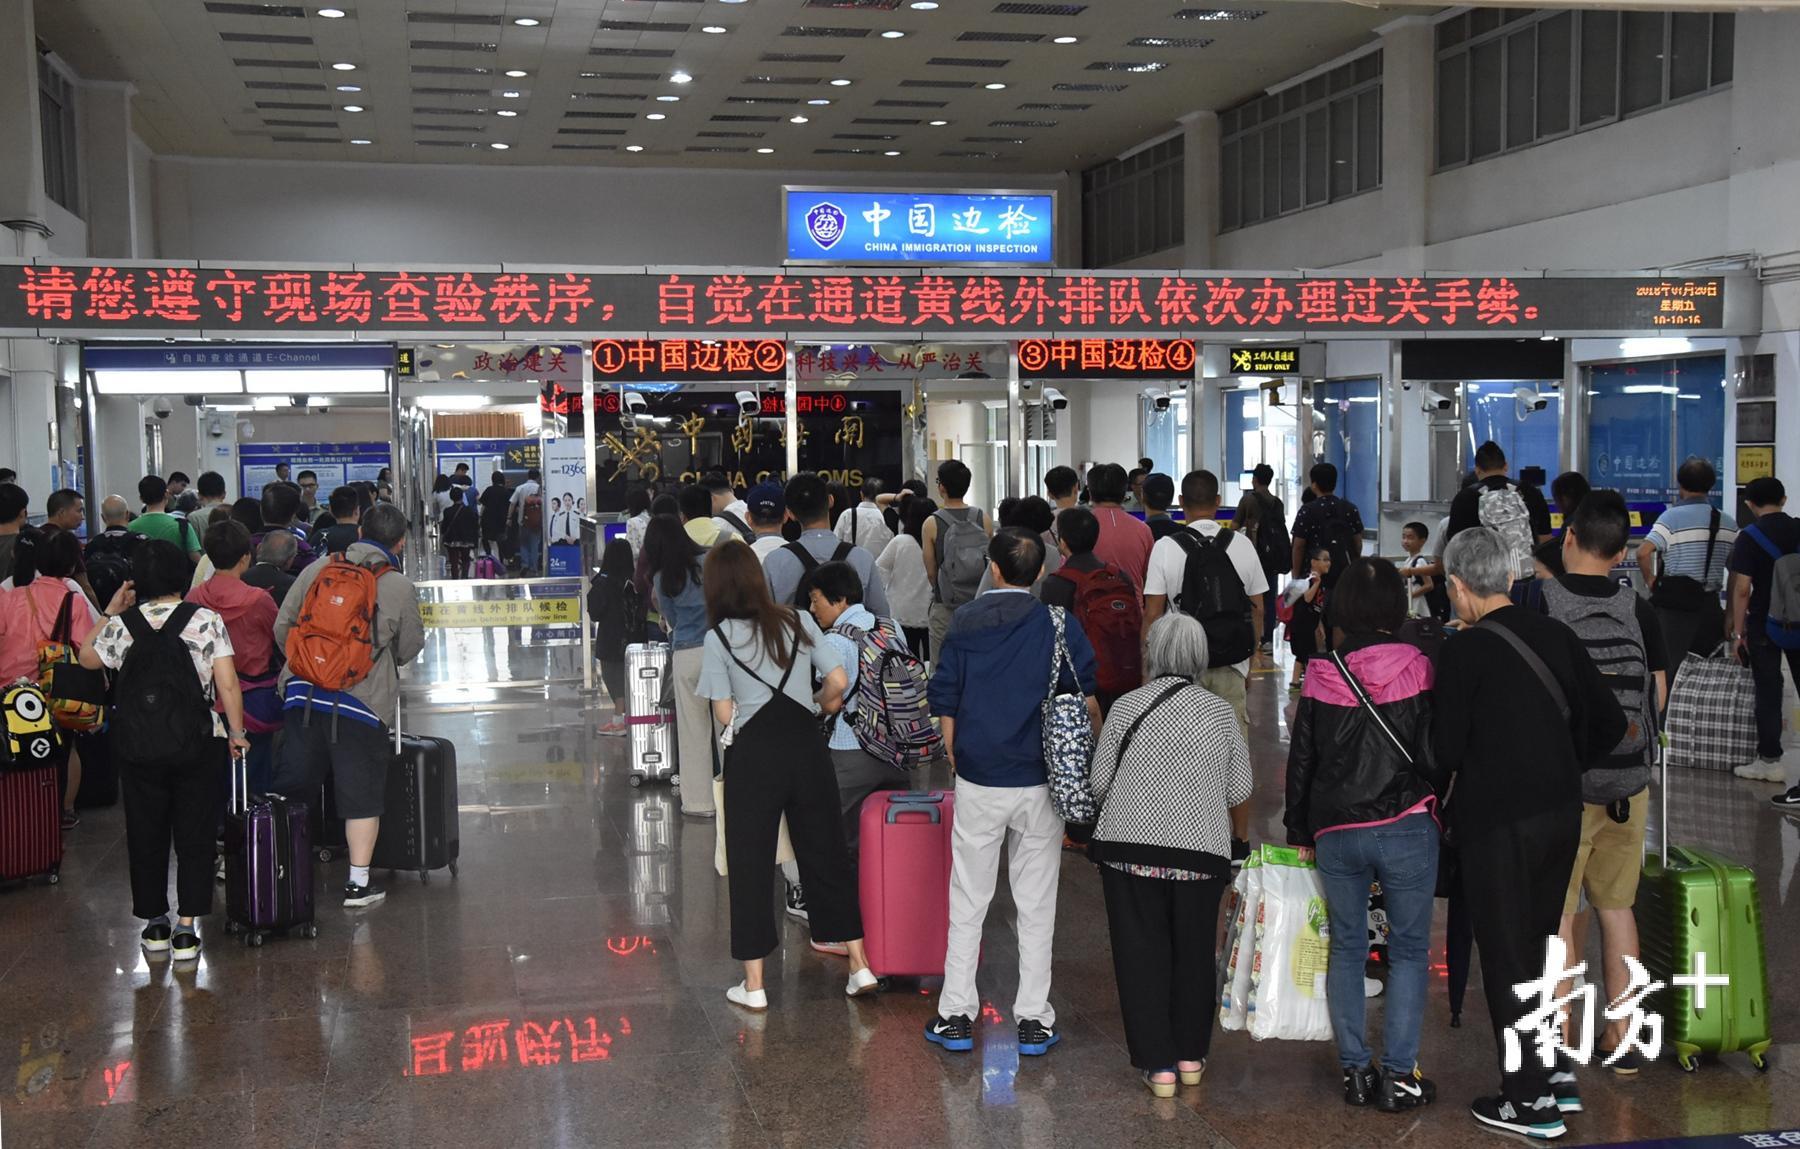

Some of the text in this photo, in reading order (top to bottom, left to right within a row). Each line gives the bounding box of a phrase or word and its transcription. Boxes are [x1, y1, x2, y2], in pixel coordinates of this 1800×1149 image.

[862, 201, 1037, 239] 中国边检
[865, 243, 1038, 253] CHINA IMMIGRATION INSPECTION
[1660, 300, 1696, 311] 星期五
[182, 353, 262, 363] 自助查验通道
[266, 353, 320, 362] E-Channel
[472, 351, 568, 374] 政治建关
[897, 350, 985, 372] 从严治关
[422, 600, 568, 616] 请在黄线外排队候检
